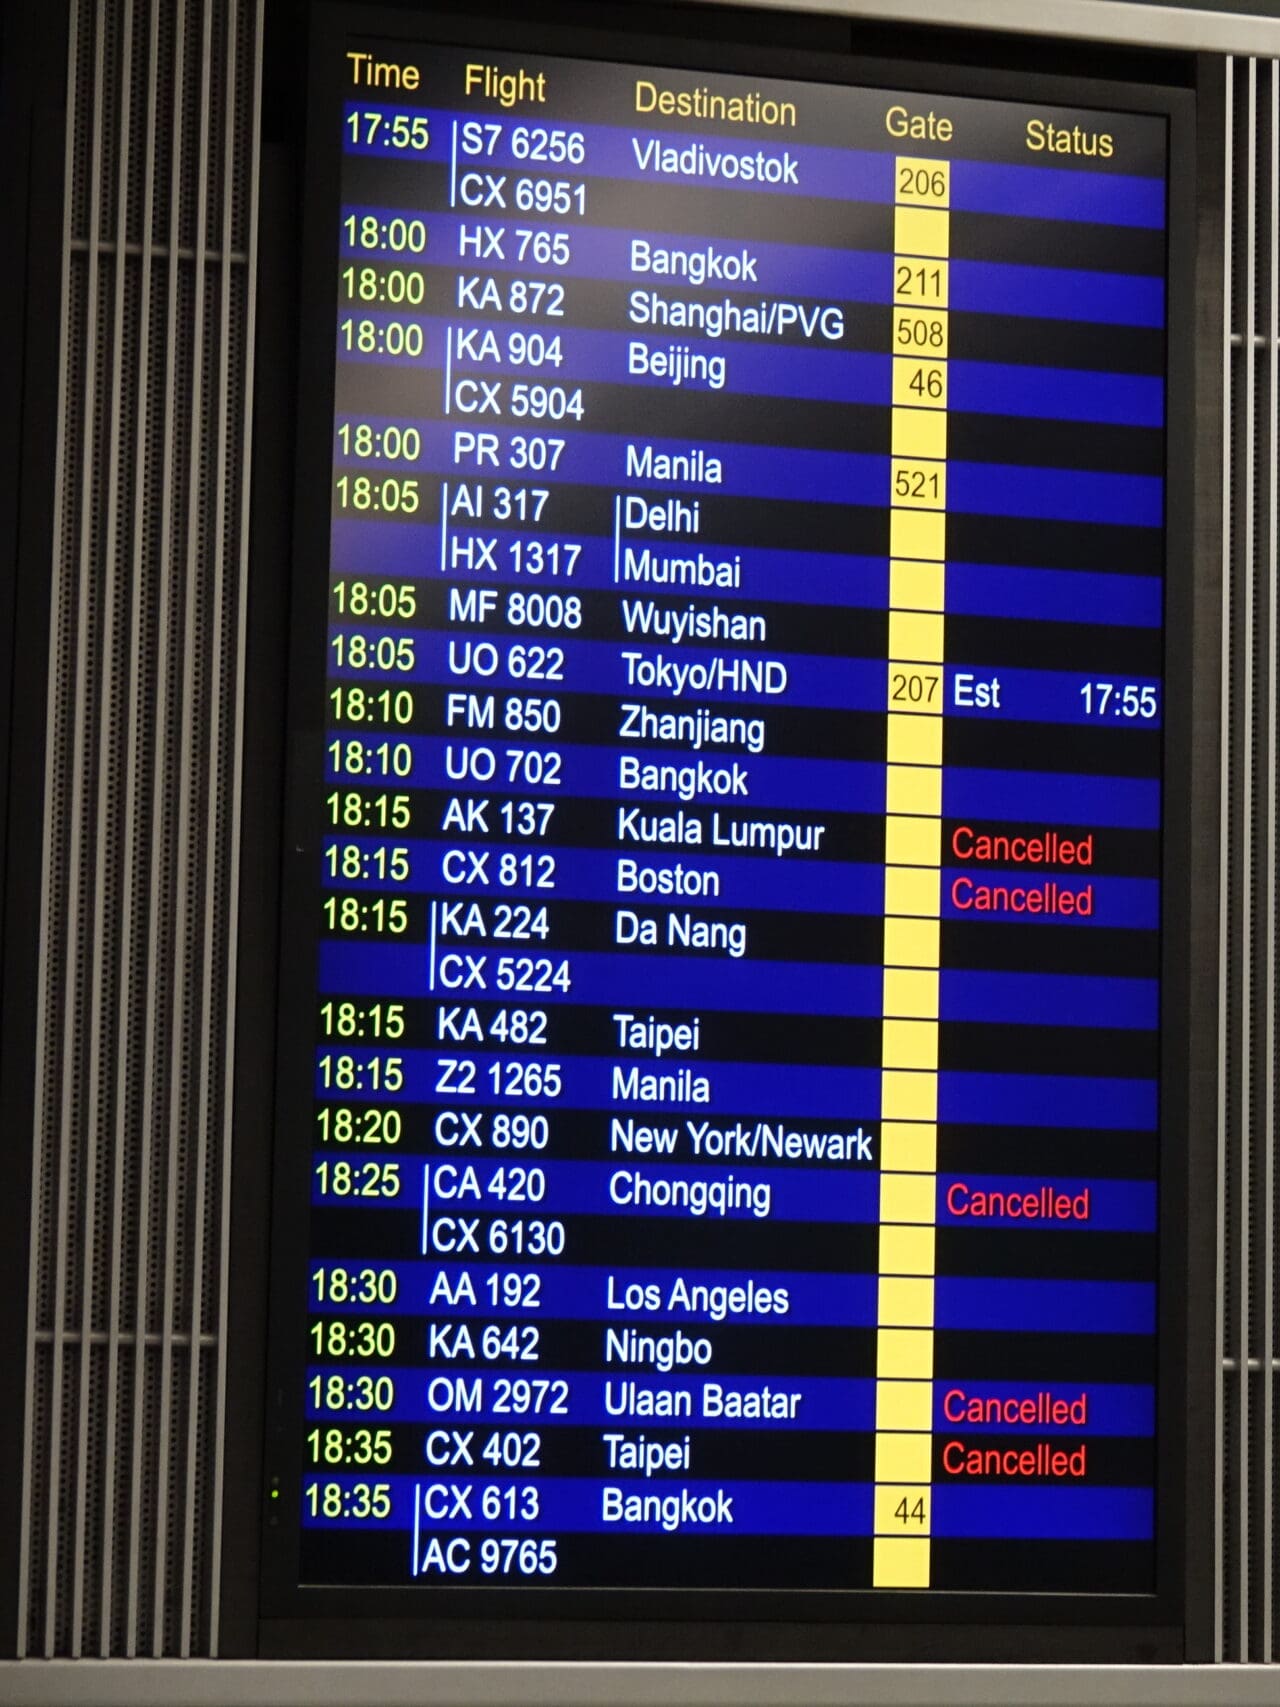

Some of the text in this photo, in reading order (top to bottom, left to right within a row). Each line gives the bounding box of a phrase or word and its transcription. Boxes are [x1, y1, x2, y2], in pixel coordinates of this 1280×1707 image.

[346, 51, 420, 90] Time
[465, 63, 546, 108] Flight
[636, 81, 799, 128] Destination
[885, 105, 955, 143] Gate
[346, 111, 429, 150] 17:55
[461, 121, 585, 165] S7 6256
[1025, 118, 1114, 158] Status
[631, 137, 799, 185] Vladivostok
[900, 168, 945, 197] 206
[459, 223, 570, 266] HX 765
[630, 239, 758, 285] Bangkok
[342, 265, 425, 305] 18:00
[896, 266, 940, 297] 211
[629, 290, 845, 341] Shanghai/PVG
[898, 318, 944, 347] 508
[456, 327, 564, 368] KA 904
[628, 341, 726, 390] Beijing
[909, 368, 943, 398] 46
[336, 423, 422, 461] 18:00
[626, 444, 723, 484] Manila
[335, 475, 421, 514] 18:05
[450, 483, 550, 522] AI 317
[895, 470, 938, 498] 521
[625, 495, 700, 534] Delhi
[623, 547, 741, 589] Mumbai
[449, 587, 583, 630] MF 8008
[621, 599, 766, 645] Wuyishan
[331, 633, 415, 672] 18:05
[620, 651, 788, 697] Tokyo/HND
[892, 674, 939, 702] 207
[954, 673, 1001, 709] Est
[447, 693, 561, 734] FM 850
[1080, 682, 1157, 719] 17:55
[618, 703, 765, 754] Zhanjiang
[328, 739, 412, 777] 18:10
[619, 755, 749, 801] Bangkok
[618, 807, 826, 857] Kuala Lumpur
[952, 826, 1093, 866] Cancelled
[325, 843, 410, 881] 18:15
[441, 849, 556, 889] CX 812
[616, 858, 720, 897] Boston
[323, 896, 408, 934] 18:15
[615, 910, 747, 958] Da Nang
[439, 953, 572, 993] CX 5224
[612, 1013, 700, 1058] Taipei
[318, 1054, 404, 1092] 18:15
[434, 1058, 562, 1098] Z2 1265
[612, 1065, 710, 1103] Manila
[610, 1117, 873, 1161] New York/Newark
[315, 1160, 401, 1198] 18:25
[433, 1163, 546, 1202] CA 420
[609, 1169, 771, 1218] Chongqing
[946, 1182, 1089, 1220] Cancelled
[428, 1270, 541, 1308] AA 192
[607, 1275, 790, 1322] Los Angeles
[310, 1320, 396, 1358] 18:30
[605, 1327, 713, 1373] Ningbo
[308, 1374, 394, 1411] 18:30
[604, 1380, 802, 1419] Ulaan Baatar
[425, 1429, 541, 1467] CX 402
[602, 1433, 691, 1478] Taipei
[942, 1440, 1086, 1477] Cancelled
[305, 1482, 391, 1519] 18:35
[602, 1486, 734, 1532] Bangkok
[894, 1497, 926, 1524] 44
[421, 1537, 558, 1575] AC 9765
